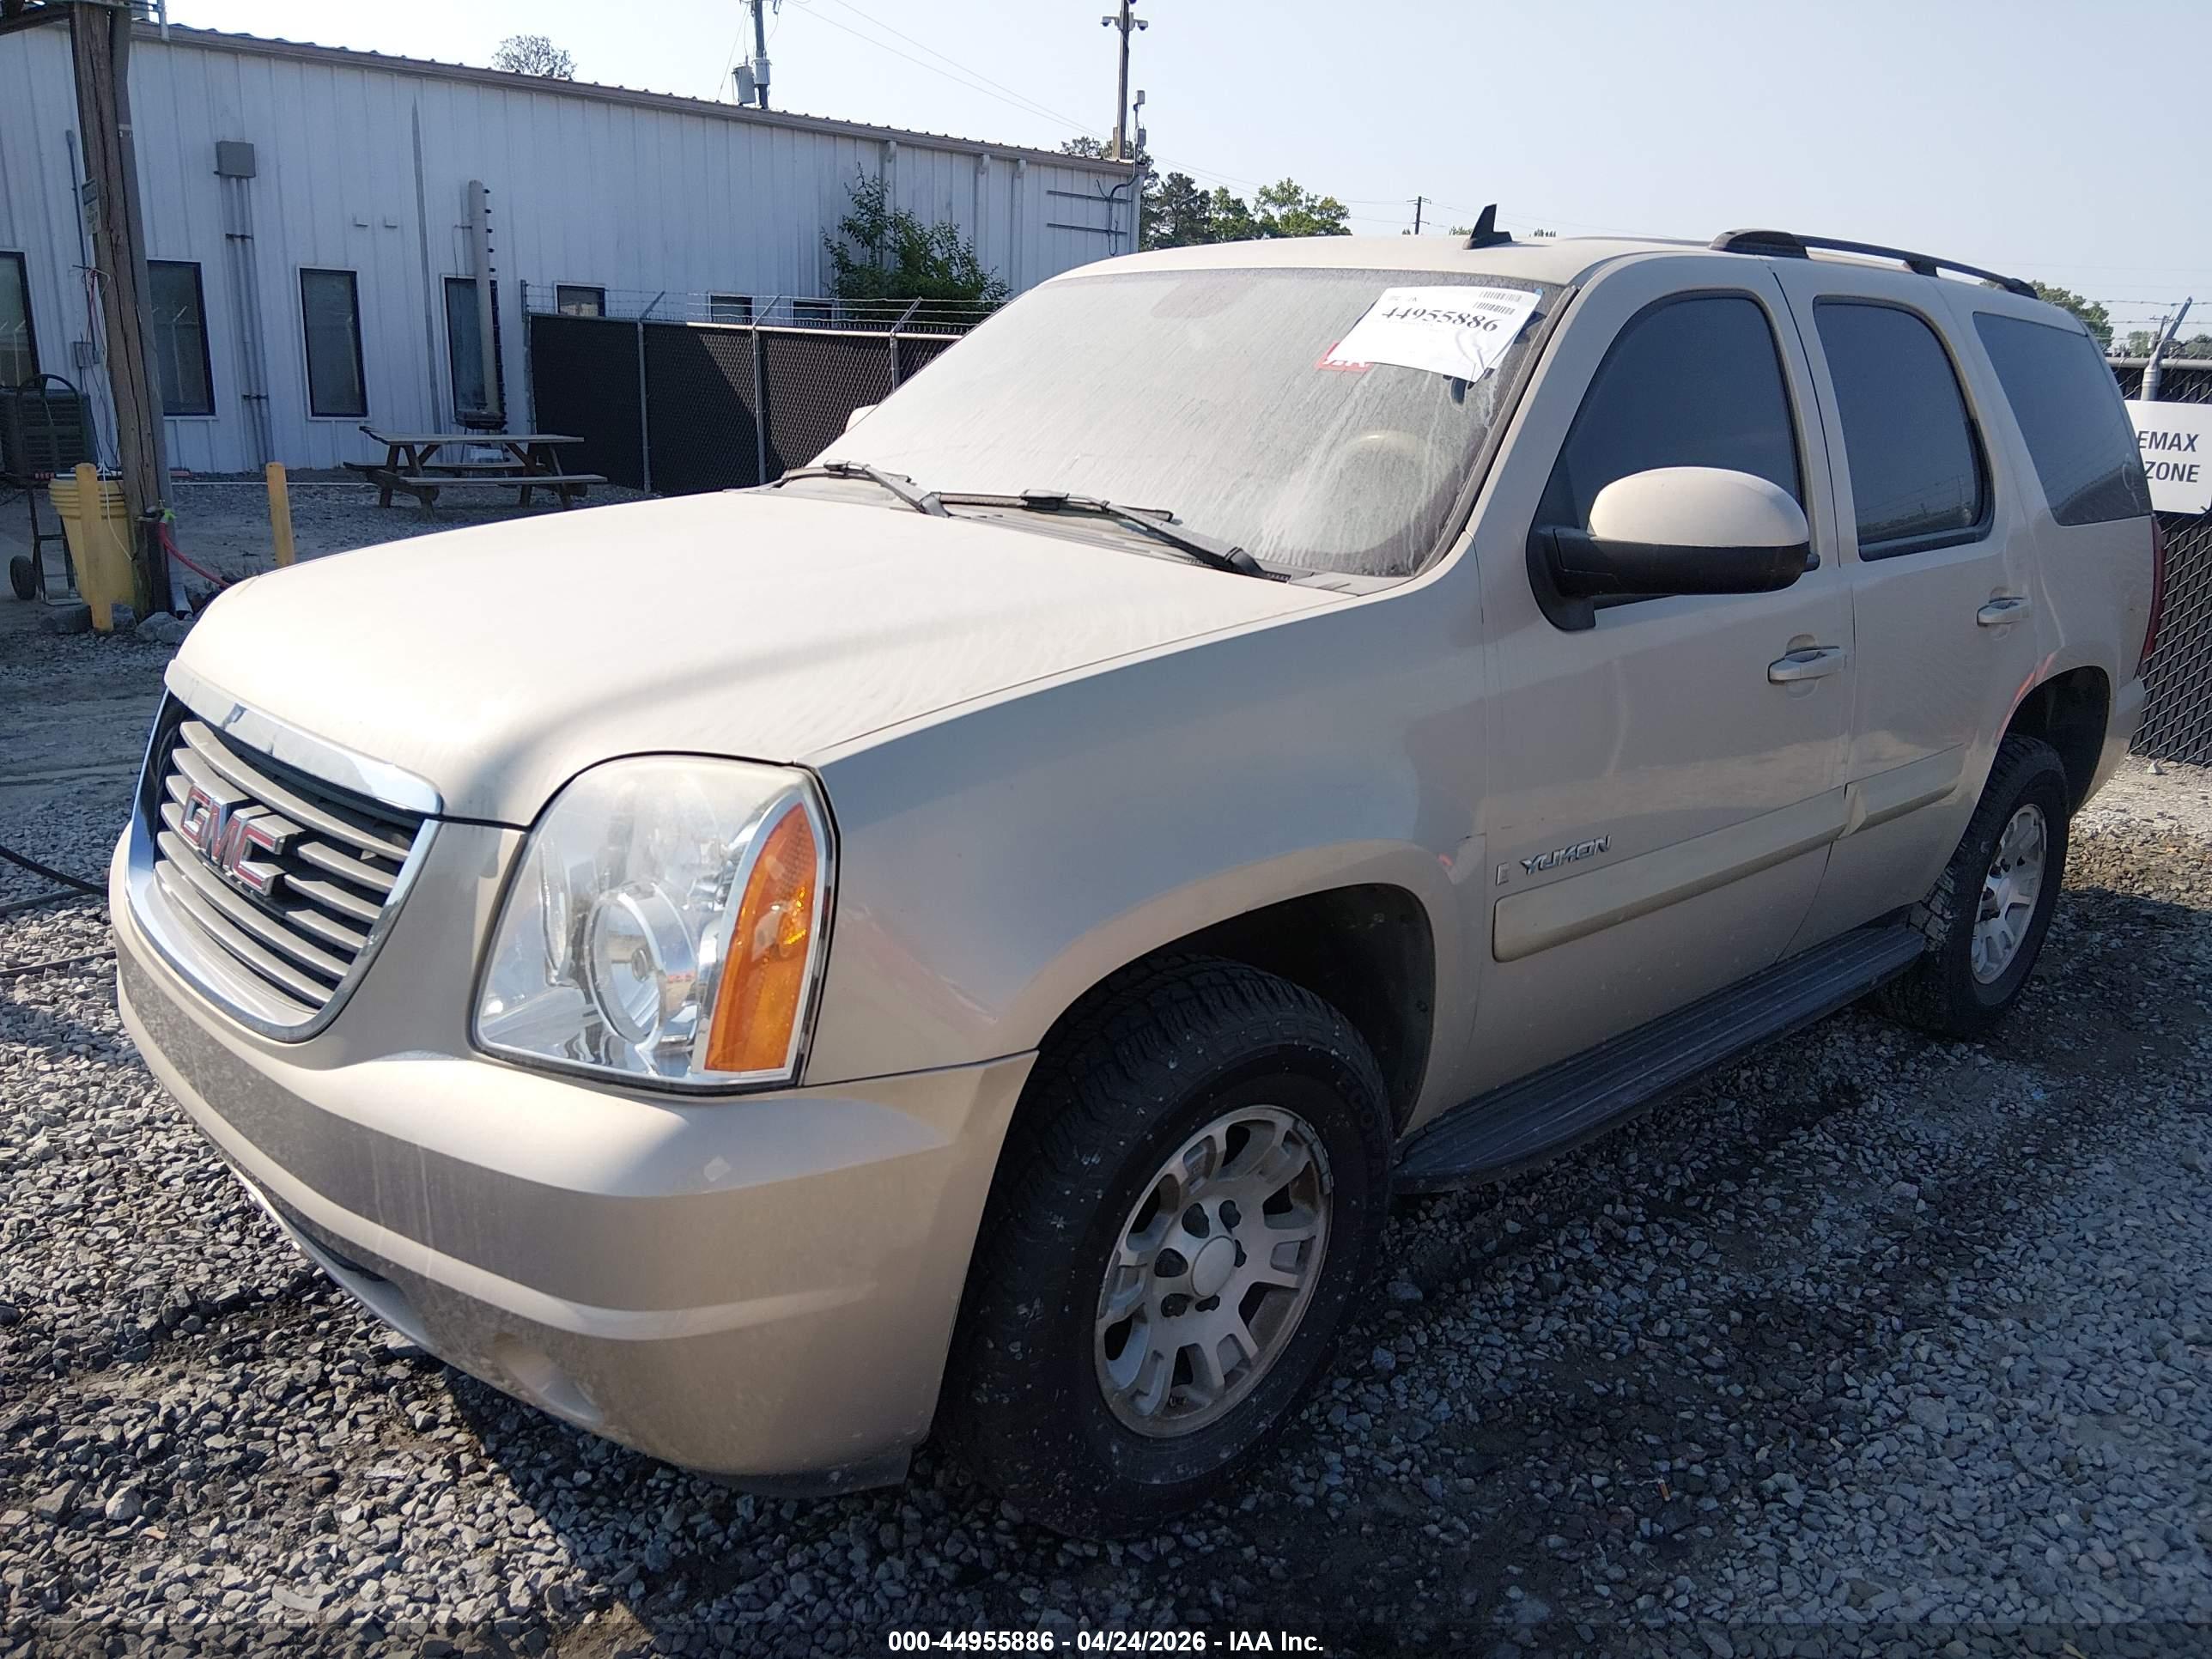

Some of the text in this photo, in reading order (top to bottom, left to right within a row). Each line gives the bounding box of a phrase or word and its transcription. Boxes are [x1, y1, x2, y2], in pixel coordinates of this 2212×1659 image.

[1382, 307, 1503, 332] 44955886
[2145, 460, 2201, 483] ZONE
[180, 784, 282, 895] GMC
[1520, 834, 1611, 876] YUKON
